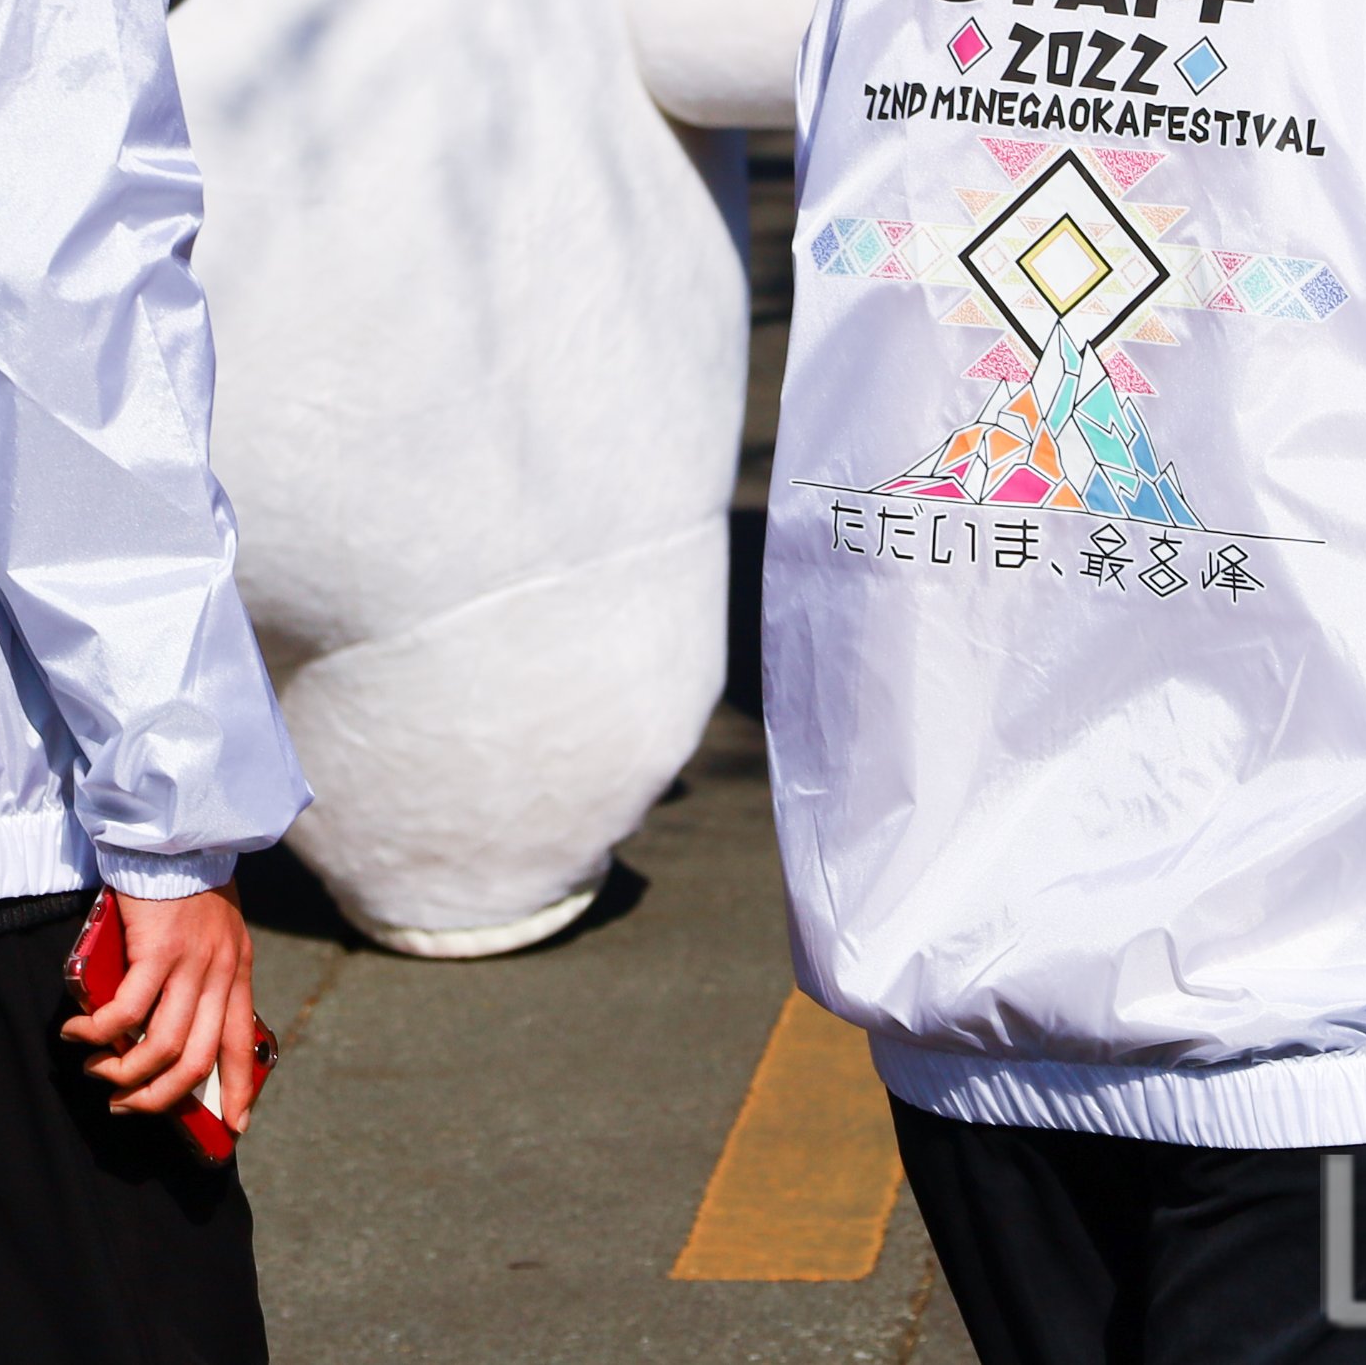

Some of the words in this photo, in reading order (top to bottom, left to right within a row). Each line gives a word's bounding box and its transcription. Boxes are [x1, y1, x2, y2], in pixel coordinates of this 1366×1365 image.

[1000, 23, 1169, 96] 2022
[863, 82, 926, 122] 72ND
[933, 87, 1327, 157] MINEGAOKAFESTIVAL
[830, 498, 1265, 603] ただいま、最高峰
